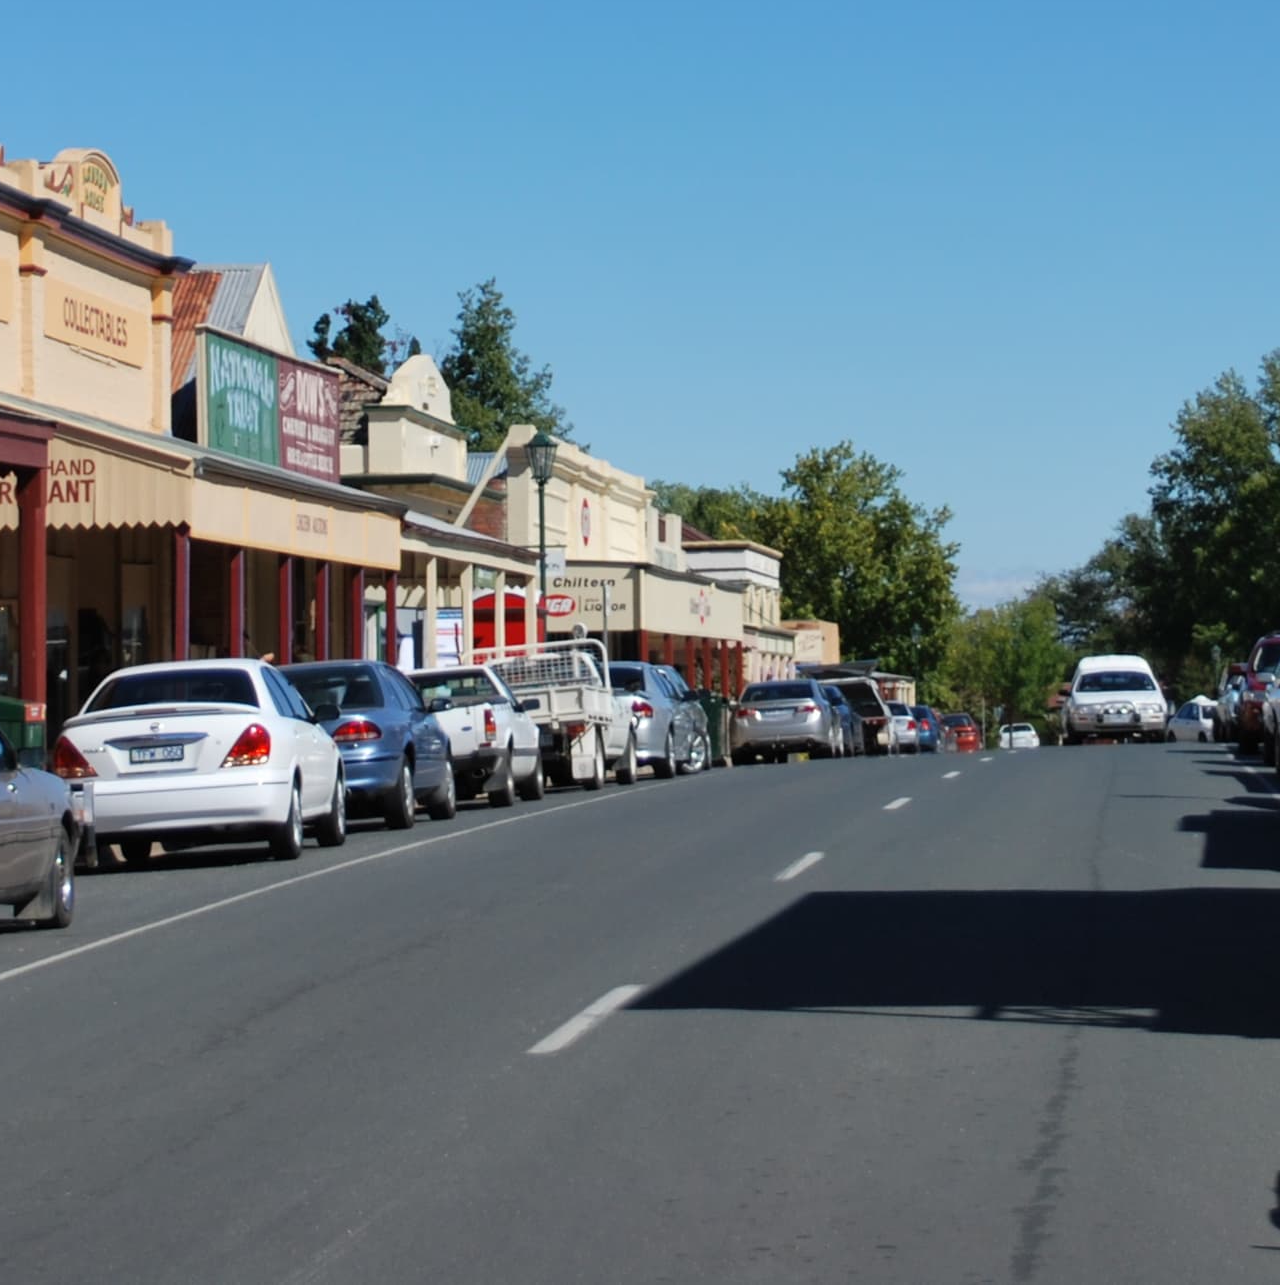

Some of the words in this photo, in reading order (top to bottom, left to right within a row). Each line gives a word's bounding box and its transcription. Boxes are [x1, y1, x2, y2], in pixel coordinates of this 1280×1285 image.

[63, 296, 129, 347] COLLECTABLES
[552, 577, 616, 588] Chiltern
[584, 603, 626, 612] LIQOR
